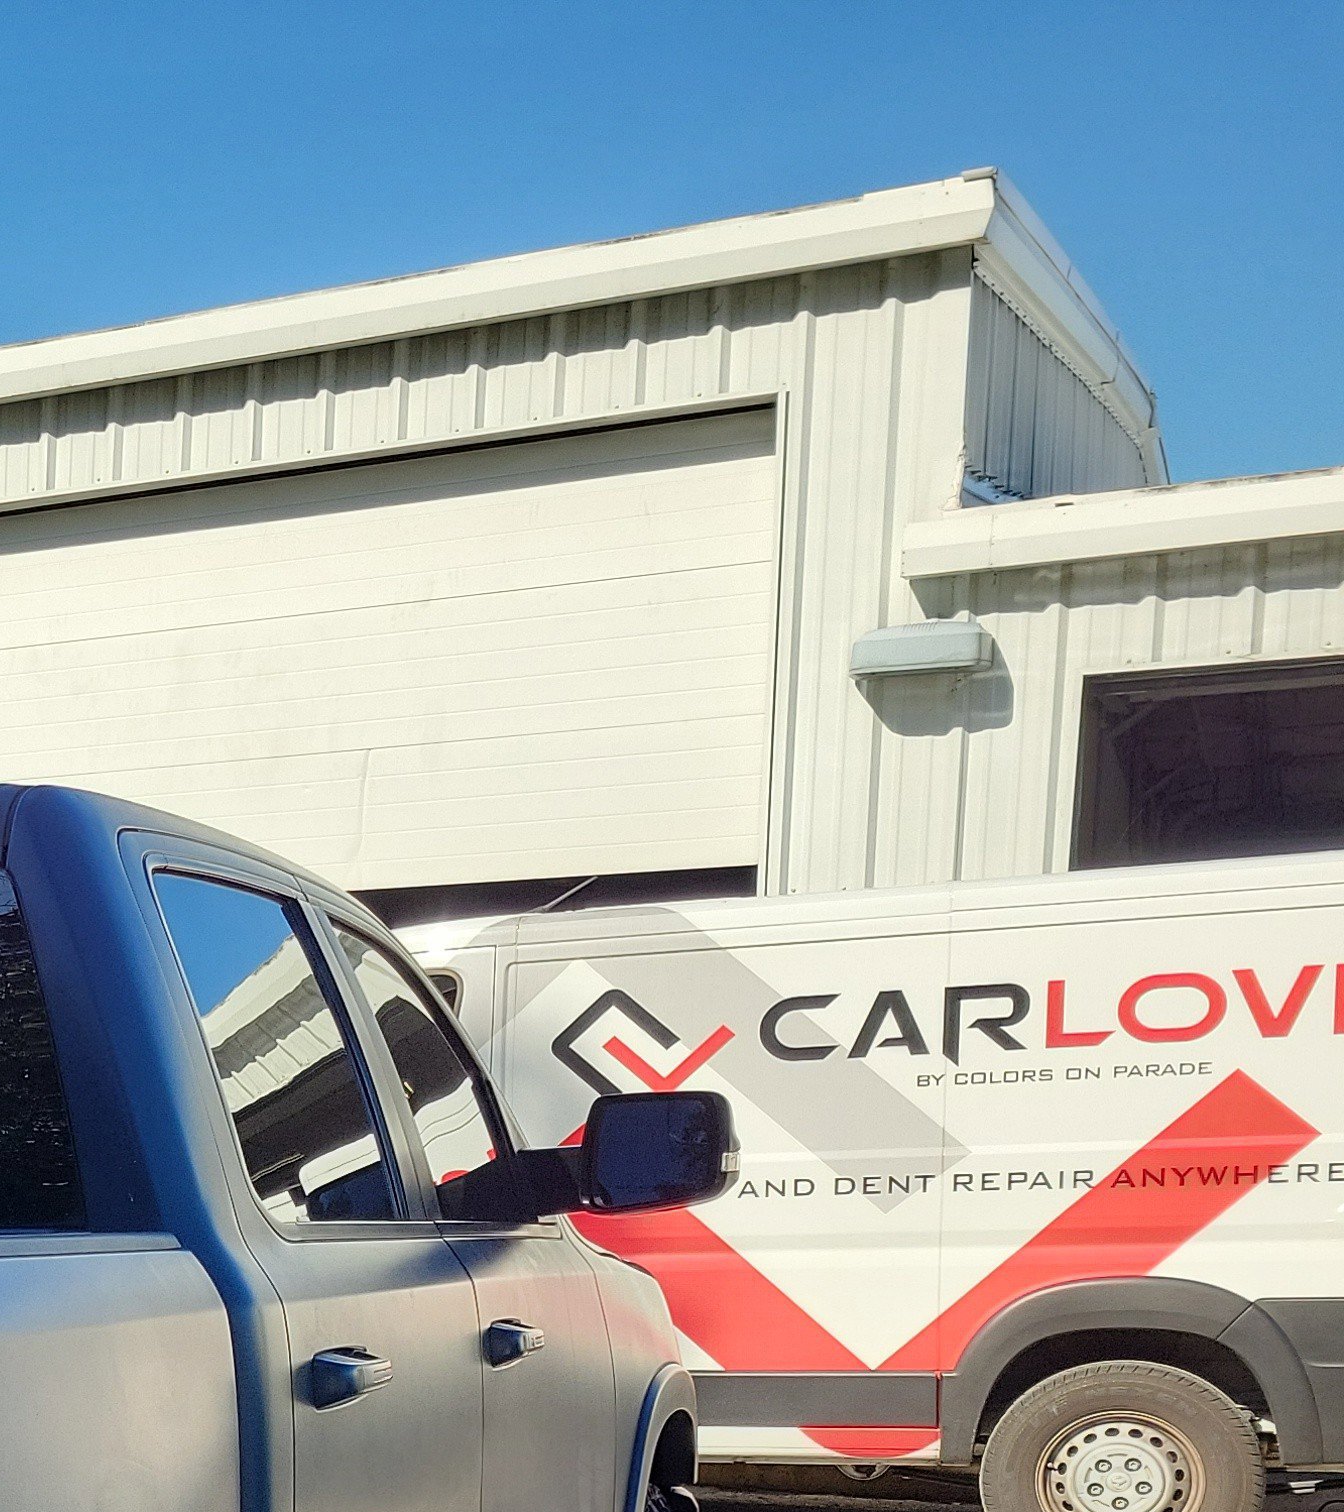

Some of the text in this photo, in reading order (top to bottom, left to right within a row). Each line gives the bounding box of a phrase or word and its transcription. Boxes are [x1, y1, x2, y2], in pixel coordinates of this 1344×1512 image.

[759, 963, 1344, 1067] CARLOV
[916, 1061, 1213, 1088] BY COLORS ON PARADE
[737, 1161, 1344, 1199] AND DENT REPAIR ANYWHERE
